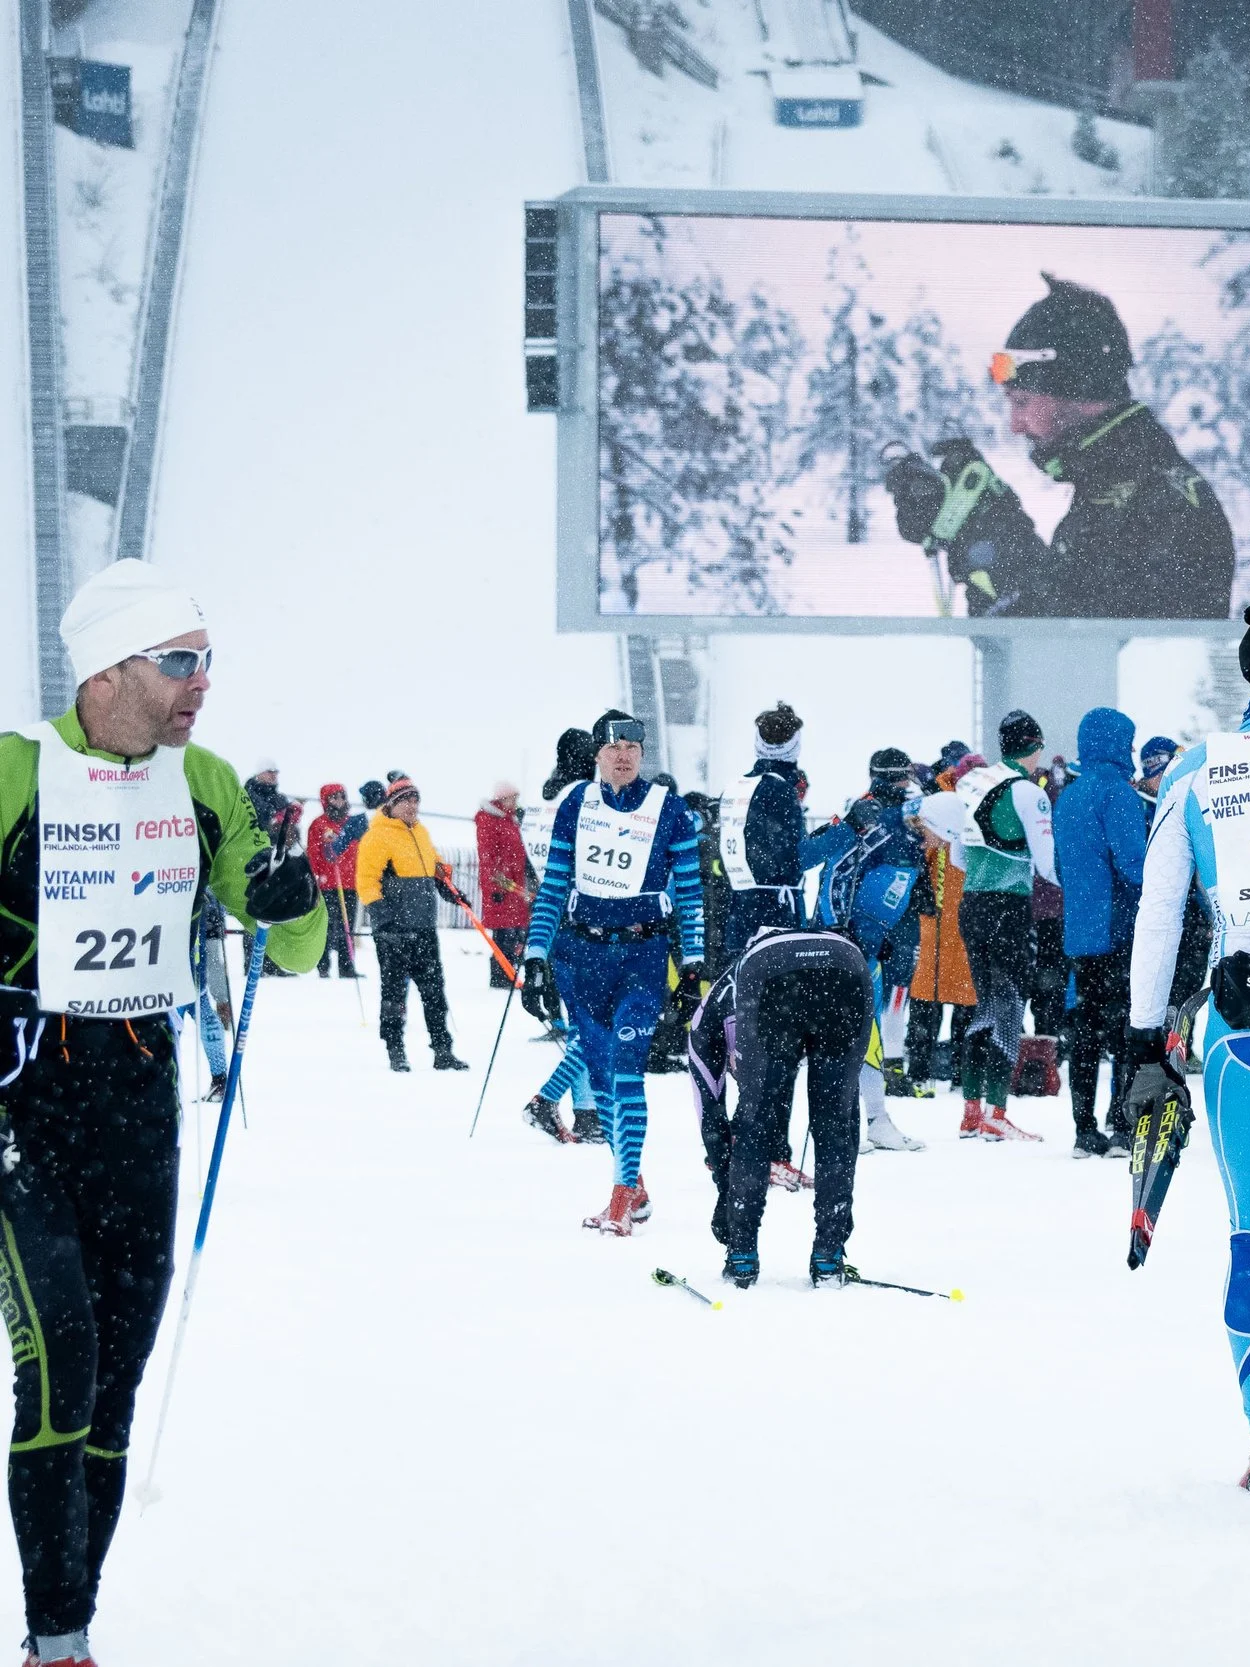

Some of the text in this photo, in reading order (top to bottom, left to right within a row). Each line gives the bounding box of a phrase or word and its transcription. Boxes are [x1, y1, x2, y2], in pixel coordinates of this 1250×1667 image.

[630, 812, 656, 825] renta
[1212, 805, 1245, 820] WELL
[136, 815, 196, 840] renta
[579, 822, 597, 832] WELL
[580, 816, 612, 830] VITAMIN
[44, 822, 120, 842] FINSKI
[586, 844, 632, 870] 219
[44, 870, 116, 885] VITAMIN
[157, 867, 196, 882] INTER
[582, 872, 632, 890] SALOMON
[44, 886, 87, 900] WELL
[157, 880, 194, 894] SPORT
[74, 924, 162, 971] 221
[64, 992, 174, 1014] SALOMON
